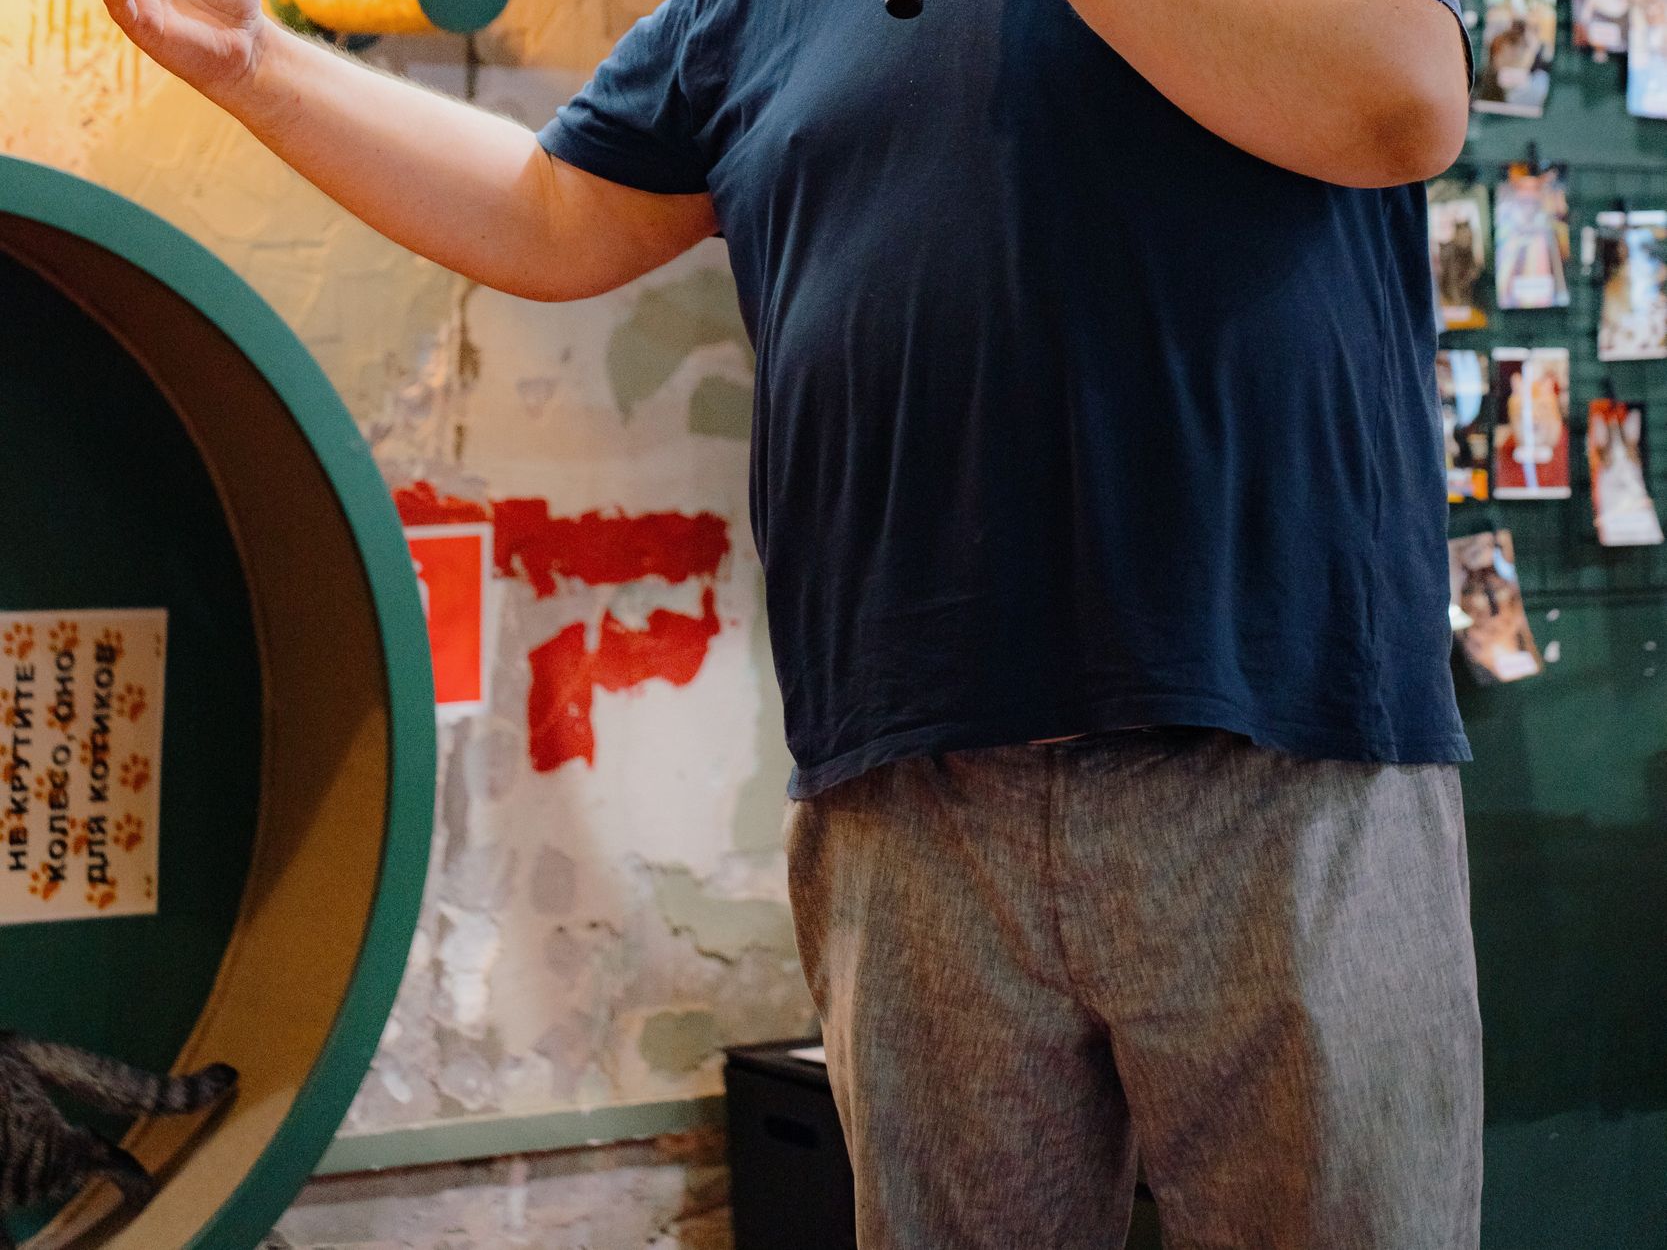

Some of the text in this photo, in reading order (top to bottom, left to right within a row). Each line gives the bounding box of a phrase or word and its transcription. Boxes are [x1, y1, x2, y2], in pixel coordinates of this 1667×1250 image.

[8, 661, 36, 872] НЕ КРУТИТЕ
[48, 649, 76, 882] КОЛЕСО, ОНО
[87, 640, 117, 885] ДЛЯ КОТИКОВ
